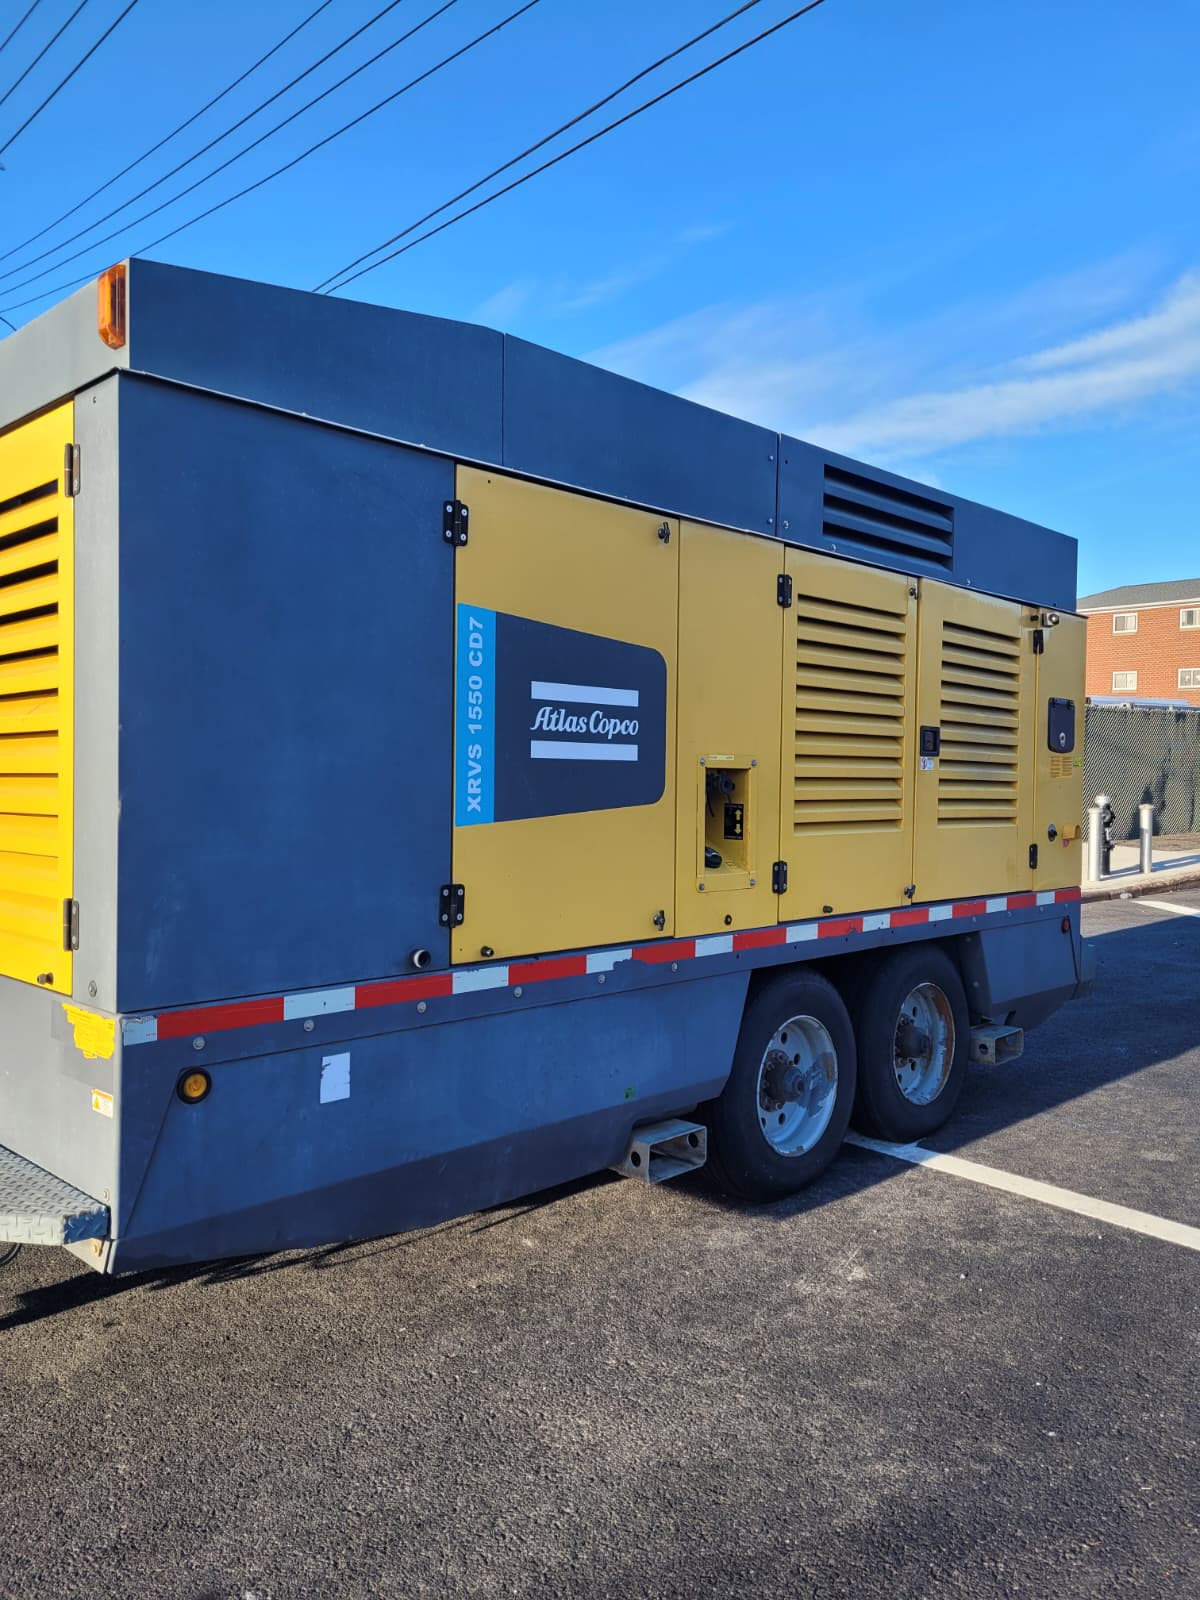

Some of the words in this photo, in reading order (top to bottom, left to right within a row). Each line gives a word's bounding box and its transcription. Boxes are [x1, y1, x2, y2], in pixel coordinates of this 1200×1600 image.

[468, 616, 484, 667] CD7
[468, 675, 483, 735] 1550
[467, 744, 483, 813] XRVS
